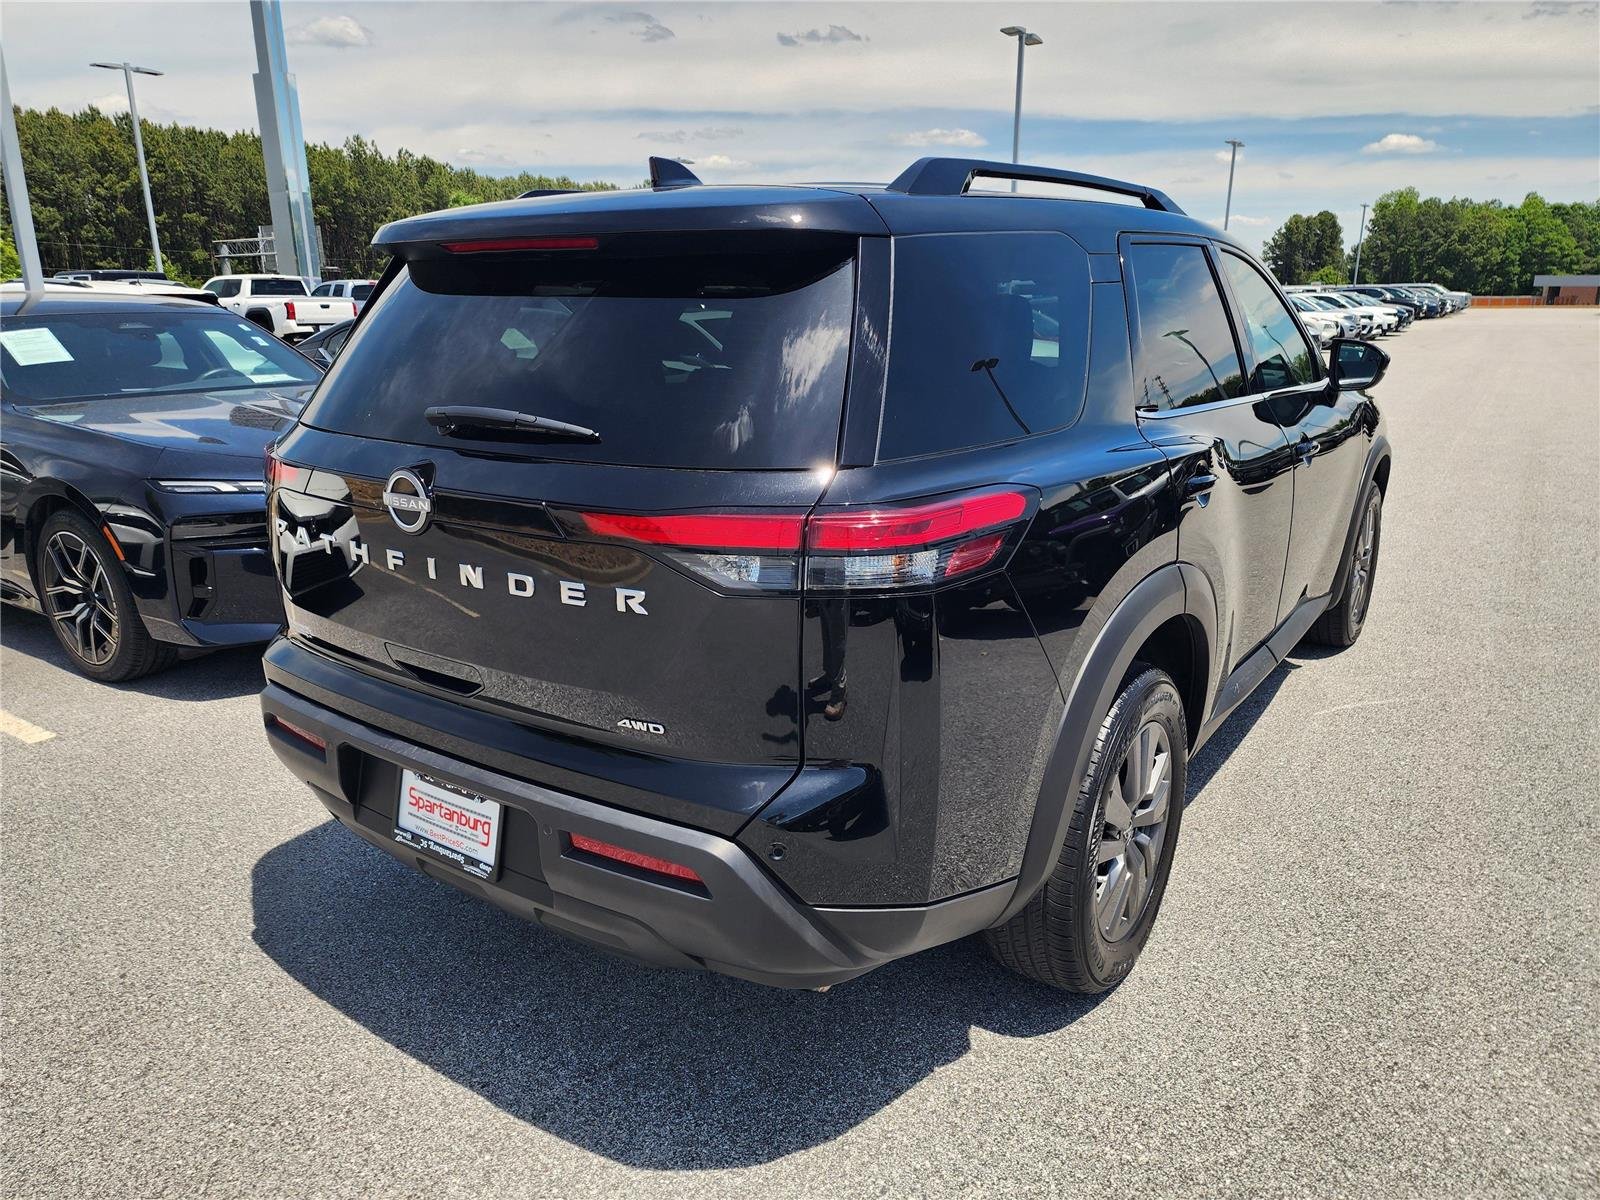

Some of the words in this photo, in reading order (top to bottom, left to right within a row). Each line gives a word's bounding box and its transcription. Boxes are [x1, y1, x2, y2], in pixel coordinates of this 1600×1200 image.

[385, 493, 429, 511] NISSAN
[274, 517, 649, 616] PATHFINDER
[617, 718, 666, 735] 4WD
[409, 786, 491, 847] Spartanburg
